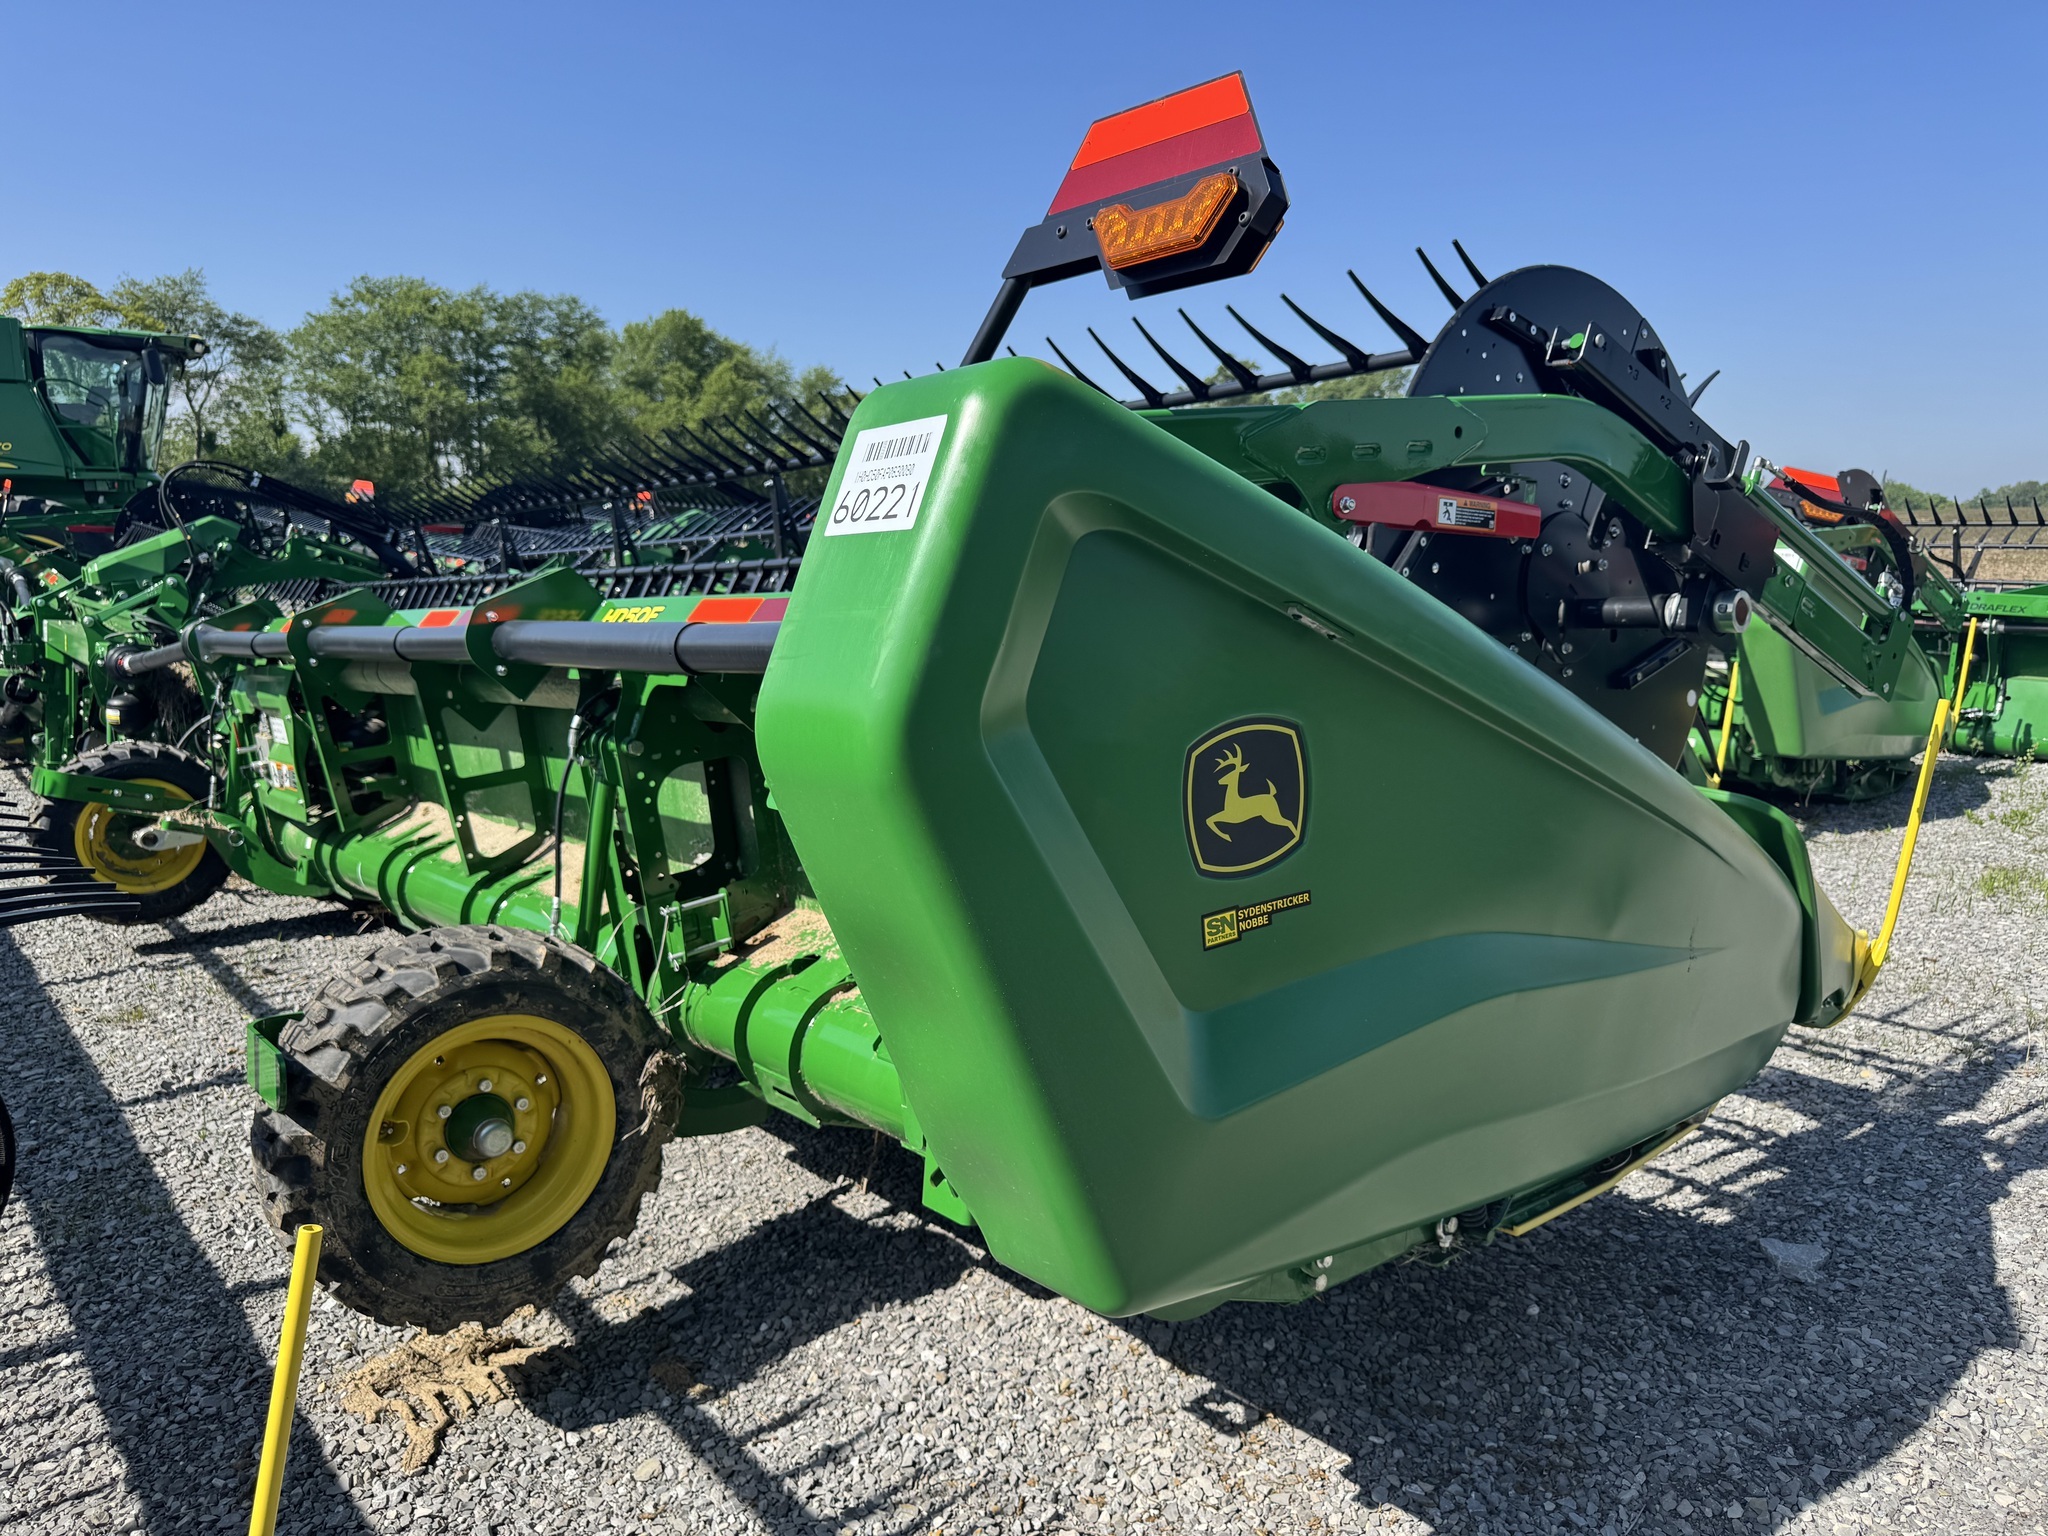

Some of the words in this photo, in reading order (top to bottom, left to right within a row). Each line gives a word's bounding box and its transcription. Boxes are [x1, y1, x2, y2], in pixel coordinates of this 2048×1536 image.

[1665, 398, 1671, 410] 2
[833, 481, 920, 524] 60221
[1469, 500, 1491, 509] WARNING
[602, 606, 666, 623] HD50F
[1970, 602, 2027, 614] DRAFLEX
[1238, 893, 1310, 919] SYDENSTRICKER
[1206, 913, 1235, 936] SN
[1239, 914, 1269, 931] NOBBE
[1207, 931, 1236, 944] PARTNERS
